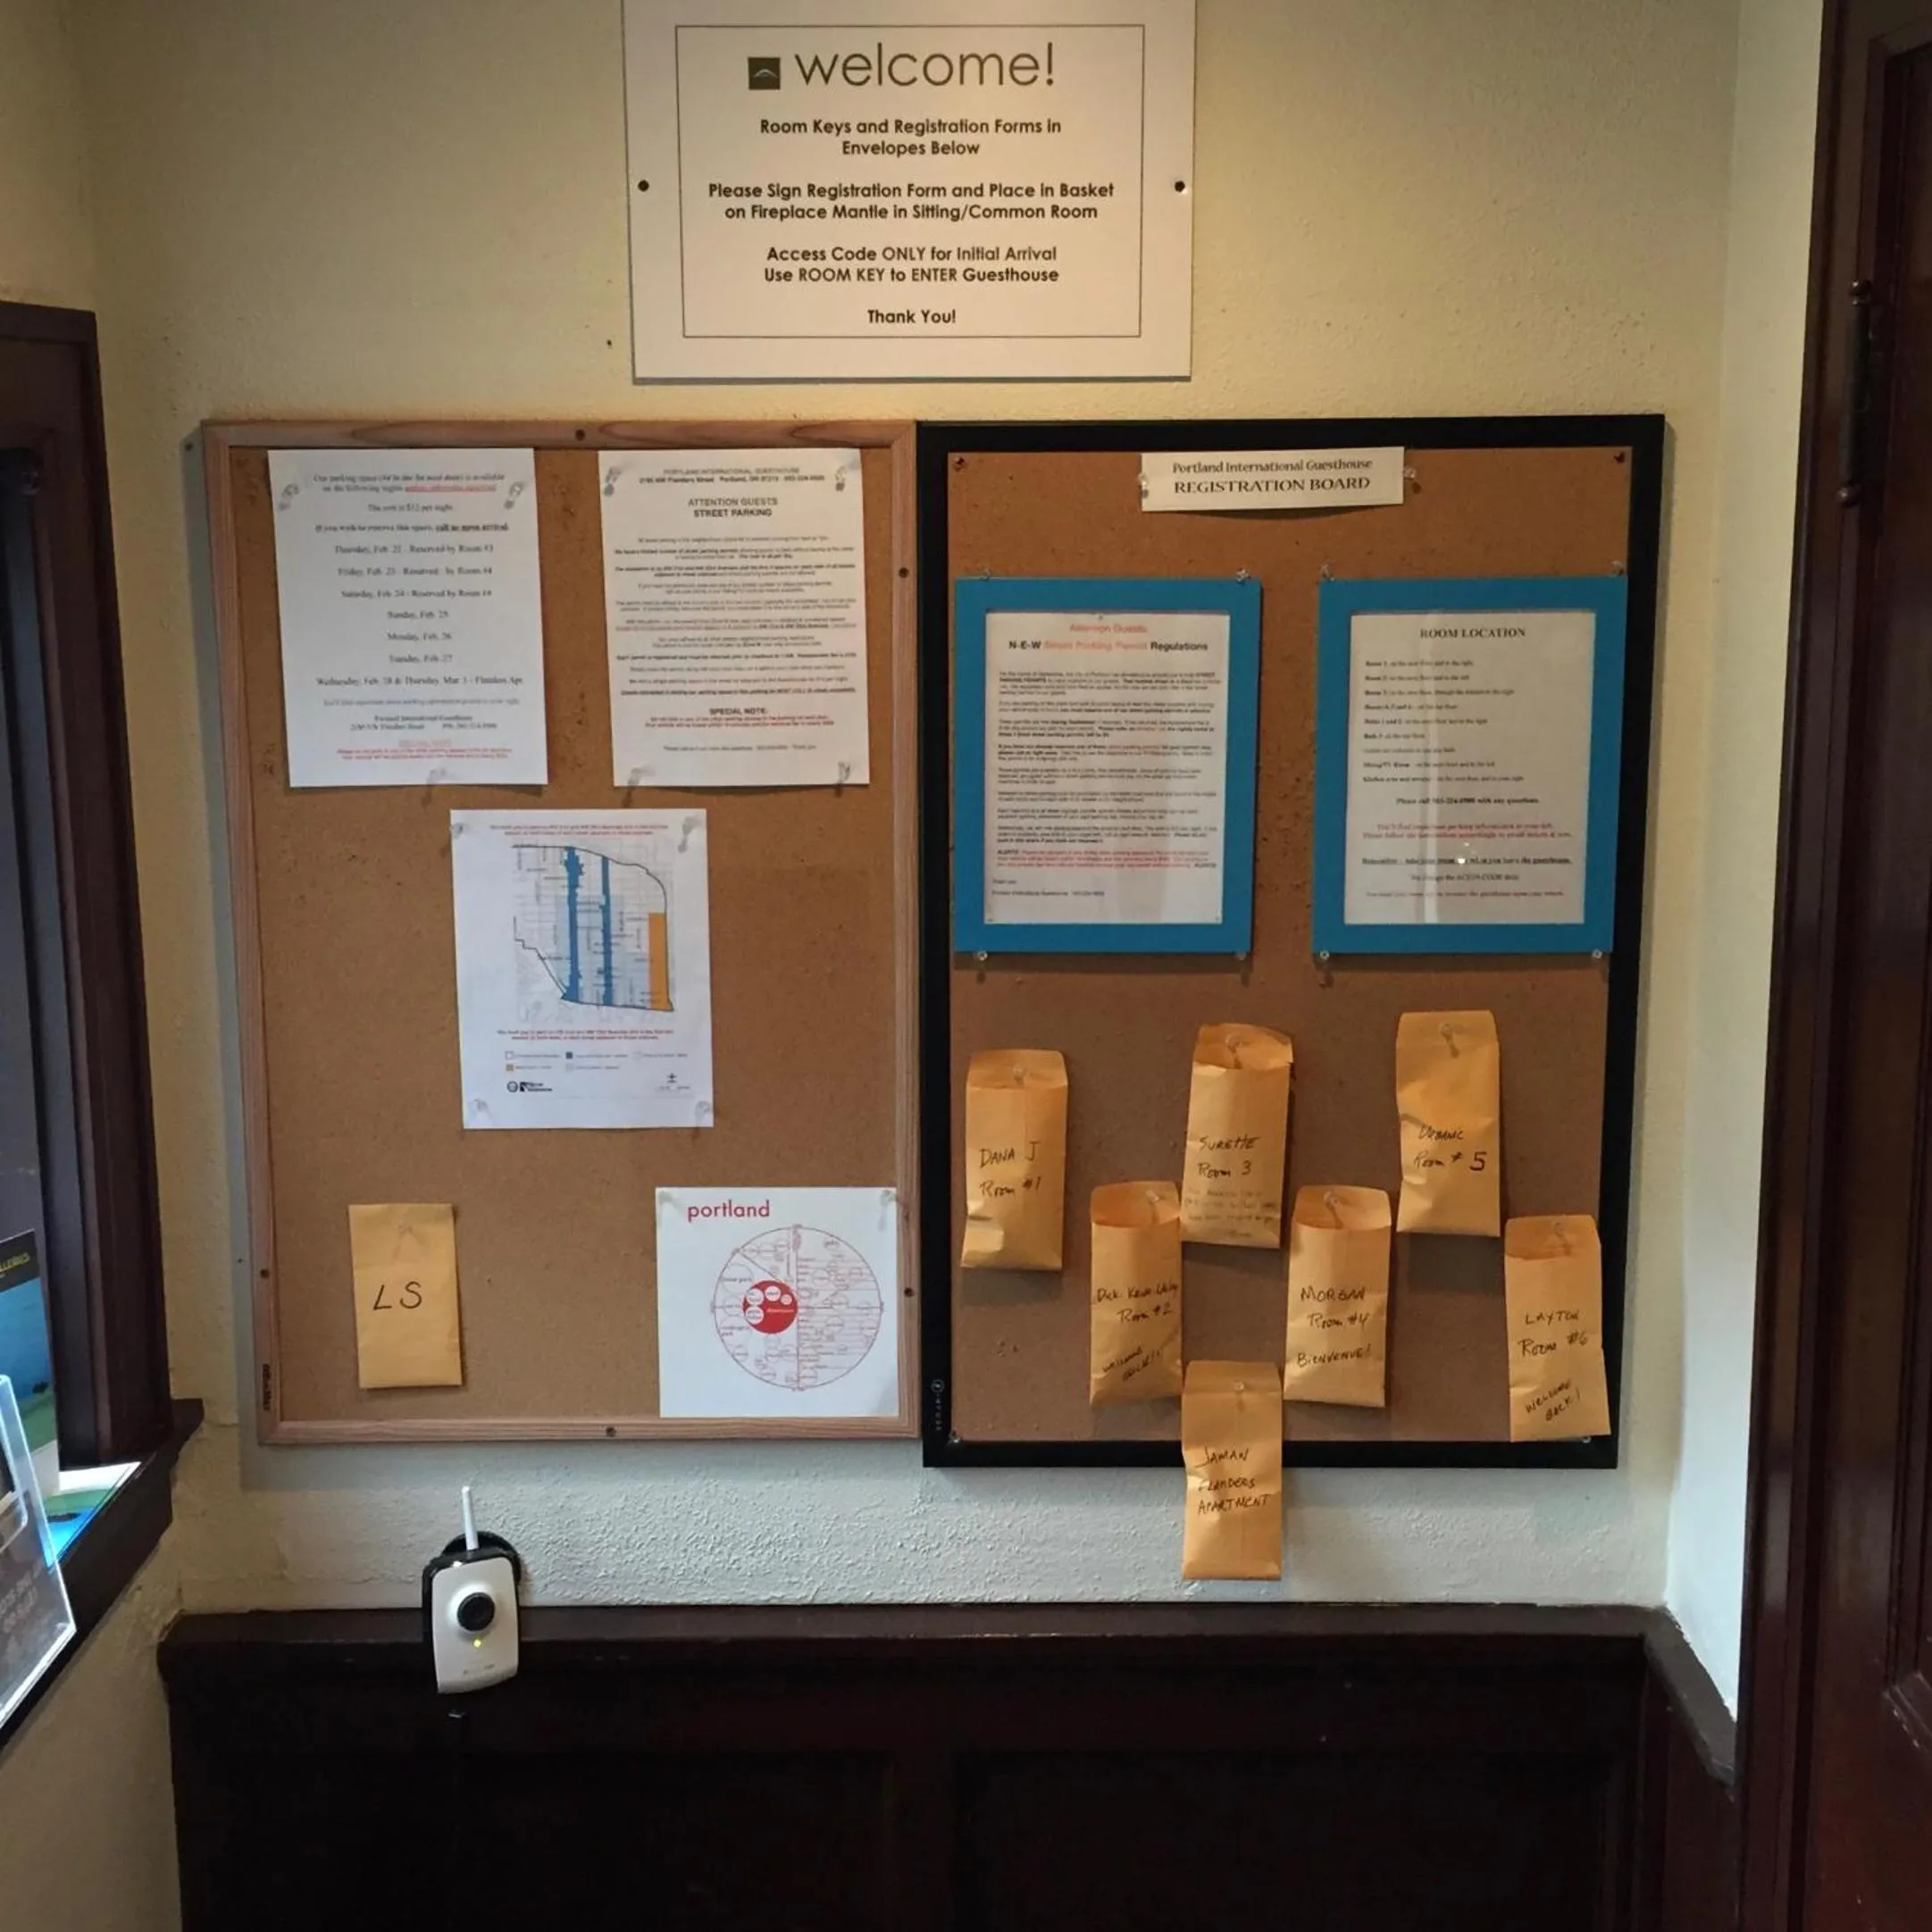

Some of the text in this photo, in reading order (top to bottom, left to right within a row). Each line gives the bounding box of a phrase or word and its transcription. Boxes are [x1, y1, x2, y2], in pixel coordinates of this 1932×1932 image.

[794, 41, 1054, 88] welcome!
[760, 118, 1062, 138] Room Keys and Registration Forms in
[841, 139, 981, 159] Envelopes Below
[708, 182, 1115, 201] Please Sign Registration Form and Place in Basket
[724, 204, 1099, 223] on Fireplace Mantle in Sitting/Common Room
[766, 246, 1058, 262] Access Code ONLY for Initial Arrival
[764, 266, 1059, 283] Use ROOM KEY to ENTER Guesthouse
[866, 308, 957, 324] Thank You!
[1172, 457, 1373, 474] Portland International Guesthouse
[1174, 477, 1371, 494] REGISTRATION BOARD
[688, 497, 778, 507] ATTENTION GUESTS
[693, 508, 773, 518] STREET PARKING
[1419, 627, 1526, 640] ROOM LOCATION
[1150, 640, 1209, 652] Regulations
[979, 1141, 1041, 1168] DANA J
[1242, 1159, 1251, 1175] 3
[687, 1198, 770, 1224] portland
[1301, 1285, 1366, 1302] MORGAN
[1347, 1311, 1370, 1330] #4
[1567, 1330, 1588, 1346] #6
[1198, 1493, 1275, 1516] APARTMENT
